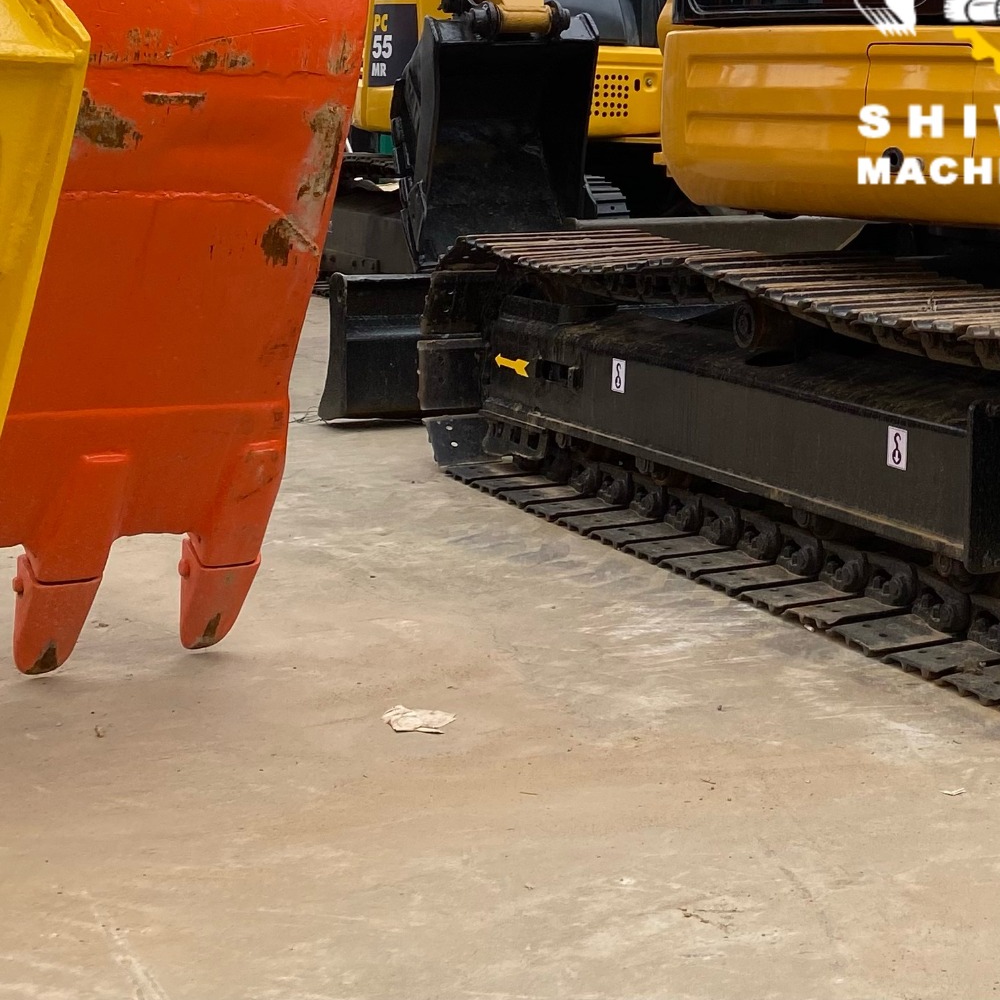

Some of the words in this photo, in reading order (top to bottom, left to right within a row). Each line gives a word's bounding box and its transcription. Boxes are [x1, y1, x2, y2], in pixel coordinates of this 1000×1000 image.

[373, 13, 389, 32] PC
[371, 34, 393, 59] 55
[371, 62, 387, 77] MR
